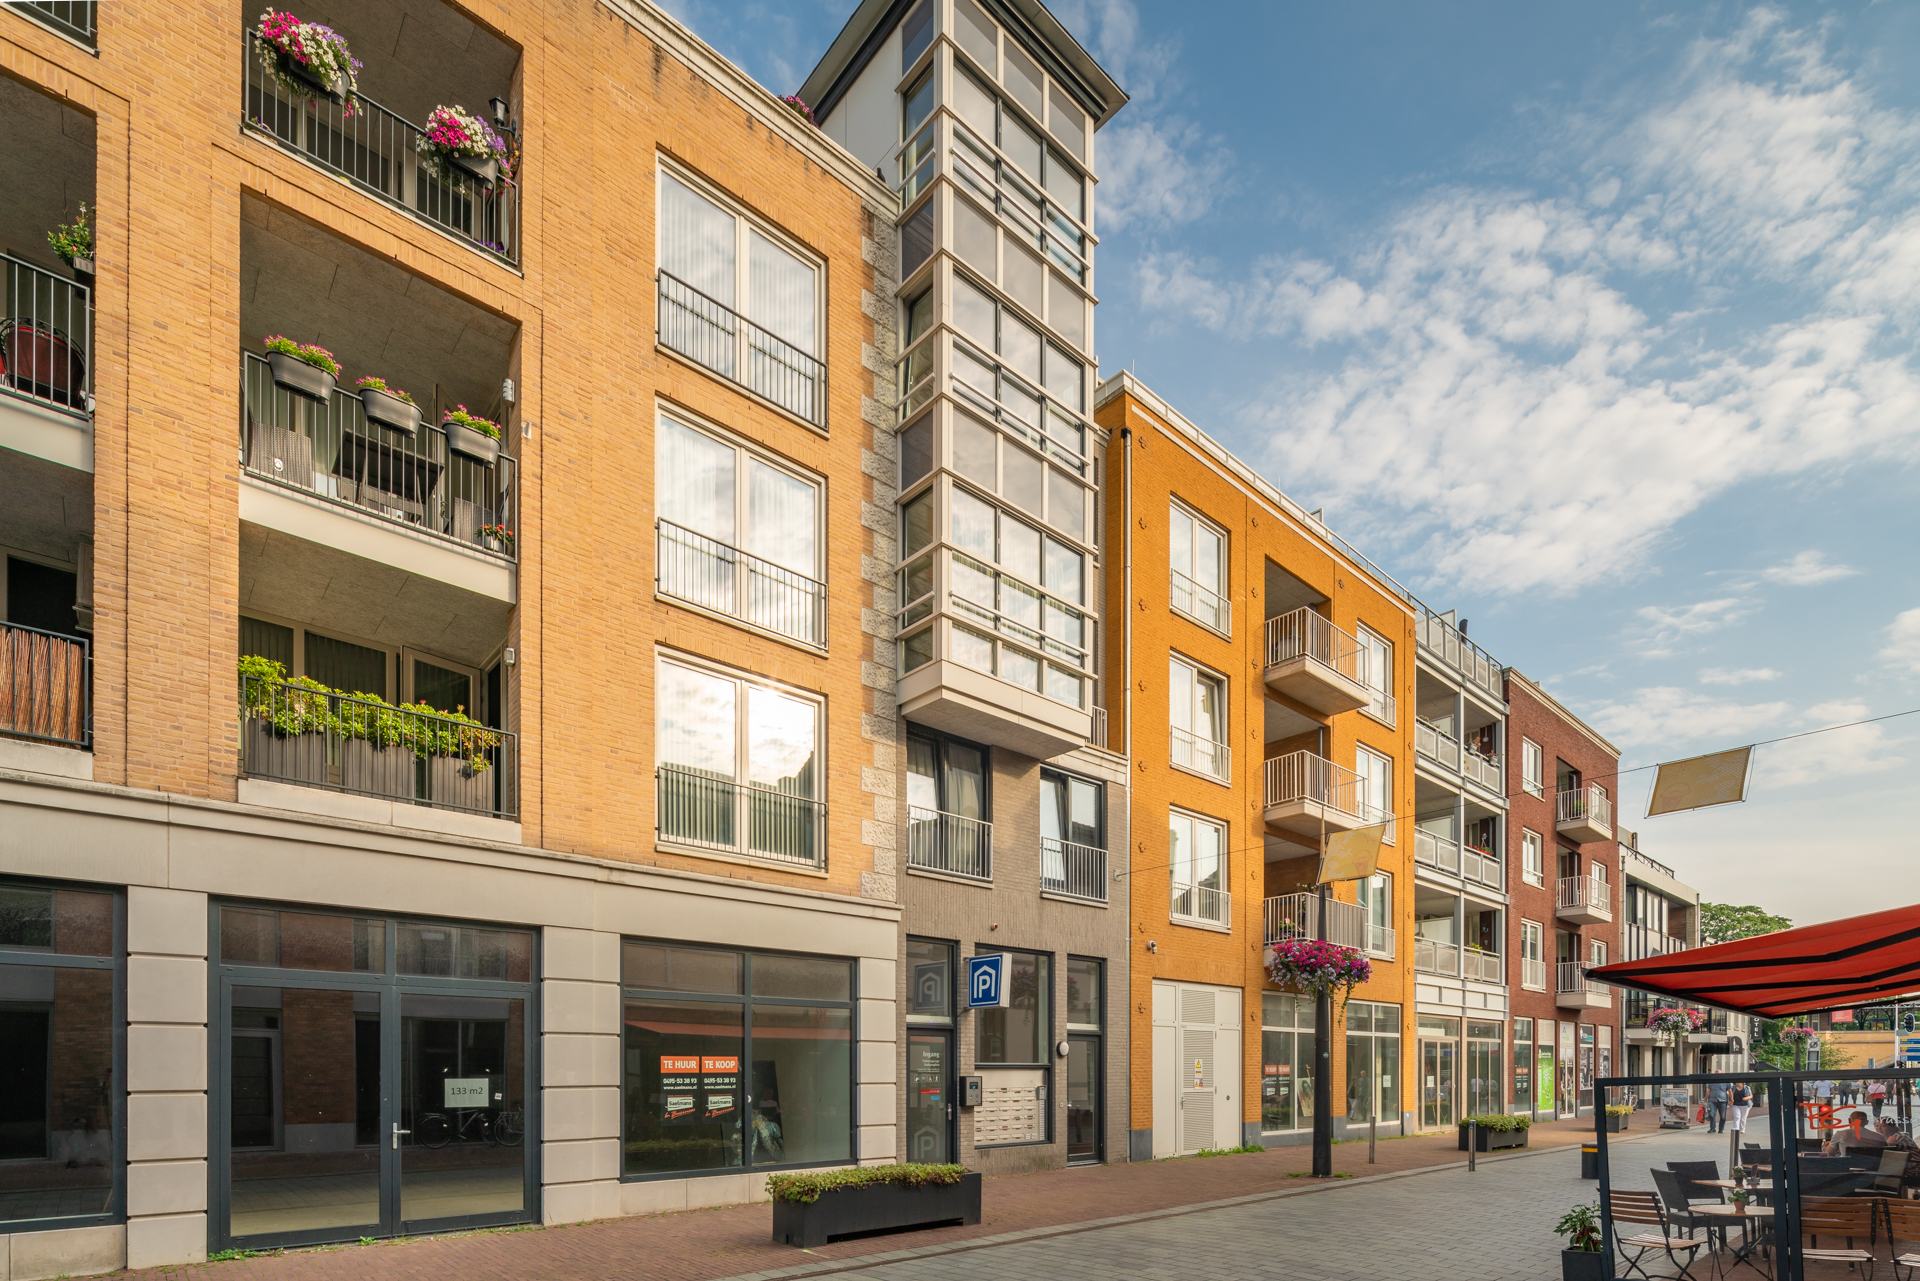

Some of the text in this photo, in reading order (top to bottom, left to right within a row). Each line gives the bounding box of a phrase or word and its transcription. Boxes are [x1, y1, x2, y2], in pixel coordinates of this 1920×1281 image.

[663, 1060, 697, 1069] TE HUUR
[704, 1060, 736, 1069] TE KOOP
[451, 1087, 484, 1095] 133 m2
